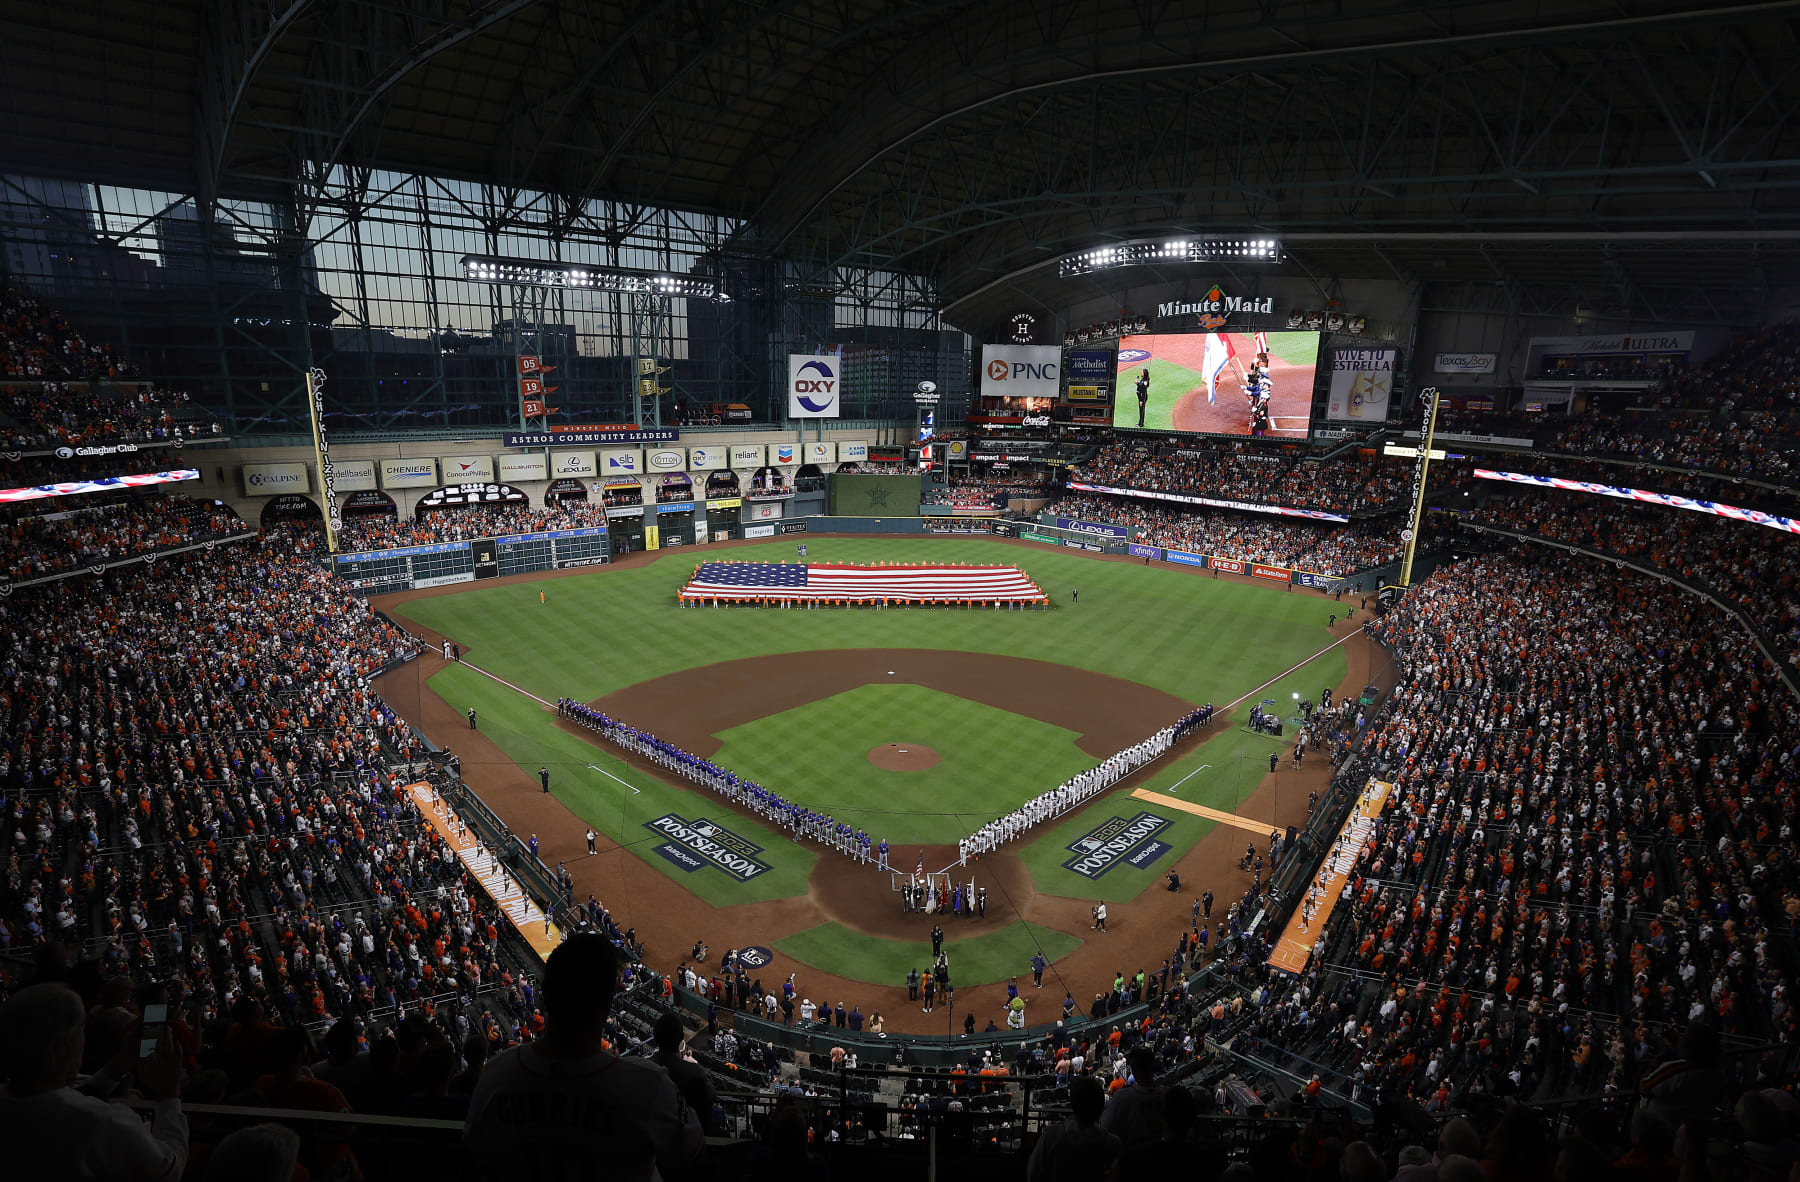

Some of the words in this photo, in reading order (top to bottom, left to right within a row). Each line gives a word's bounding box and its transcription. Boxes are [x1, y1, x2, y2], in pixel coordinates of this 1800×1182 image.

[1158, 299, 1220, 318] Minute
[1224, 296, 1273, 314] Maid
[1011, 313, 1035, 323] HOUSTON
[1199, 313, 1227, 329] Park
[1017, 323, 1028, 334] H
[1012, 335, 1033, 343] ASTROS
[1632, 337, 1679, 350] ULTRA
[1369, 350, 1384, 360] TU
[523, 360, 536, 368] 05
[1072, 359, 1107, 369] Methodist
[1333, 360, 1395, 371] ESTRELLA!
[1011, 363, 1056, 380] PNC
[526, 383, 537, 391] 19
[643, 384, 652, 392] 22
[795, 380, 835, 393] OXY
[1097, 389, 1107, 397] CAT
[527, 403, 539, 412] 21
[1023, 415, 1051, 426] Coca-Cola
[1420, 409, 1432, 441] ROOT
[511, 435, 554, 444] ASTROS
[559, 433, 625, 442] COMMUNITY
[629, 432, 673, 440] LEADERS
[75, 446, 117, 456] Gallagher
[117, 443, 138, 452] Club
[735, 451, 758, 459] reliant
[619, 454, 634, 464] slb
[387, 465, 431, 474] CHENIERE
[447, 470, 490, 478] ConocoPhillips
[264, 475, 302, 483] CALPINE
[1080, 525, 1115, 536] LEXUS
[1134, 546, 1156, 558] xfinity
[1174, 554, 1200, 565] HONDA
[1214, 560, 1238, 570] H-E-B
[1095, 820, 1128, 840] 2023
[653, 817, 762, 877] POSTSEASON
[714, 833, 754, 855] 2023
[1073, 815, 1165, 875] POSTSEASON
[741, 951, 765, 965] ALCS
